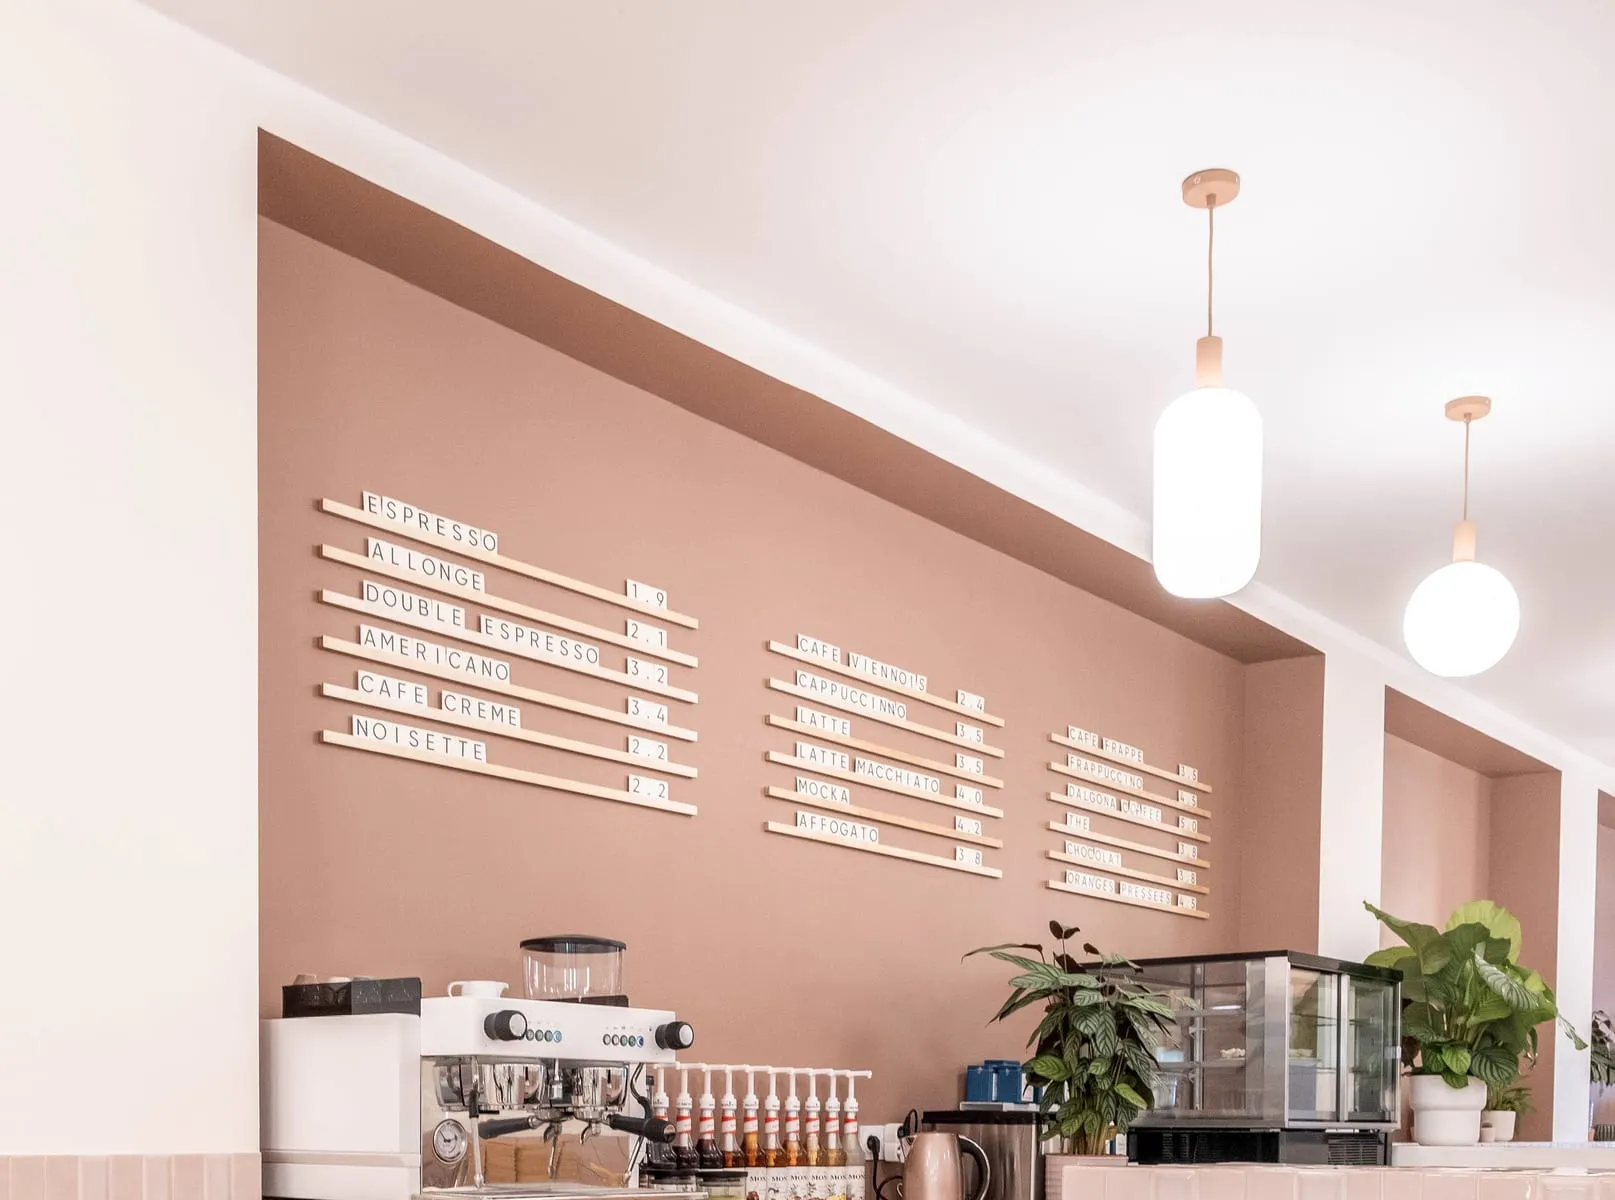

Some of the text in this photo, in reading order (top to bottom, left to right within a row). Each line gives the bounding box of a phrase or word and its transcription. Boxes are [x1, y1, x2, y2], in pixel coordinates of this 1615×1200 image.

[367, 495, 665, 607] ESPRESSO 1.9
[371, 542, 665, 647] ALLONGE 2.1
[366, 583, 666, 684] DOUBLE ESPRESSO 3.2
[363, 628, 666, 722] AMERICANO 3.4
[799, 637, 983, 711] CAFE VIENNOIS 2.4
[360, 674, 666, 760] CAFE CREME 2.2
[799, 709, 982, 773] LATTE 3.5
[959, 724, 982, 743] 3.5
[356, 718, 666, 799] NOISETTE 2.2
[799, 745, 982, 804] LATTE MACCHIATO 4.0
[1069, 728, 1197, 781] CAFE FRAPPE 3.5
[1070, 757, 1197, 807] FRAPPUCCINO 4.5
[798, 779, 981, 835] MOCKA 4.2
[1069, 787, 1116, 809] DALGONA
[1180, 818, 1197, 832] 5.0
[1069, 814, 1197, 857] THE 3.8
[799, 814, 981, 865] AFFOGATO 3.8
[1067, 844, 1196, 884] CHOCOLAT 3.8
[1067, 872, 1196, 909] ORANGES PRESSEES 4.5
